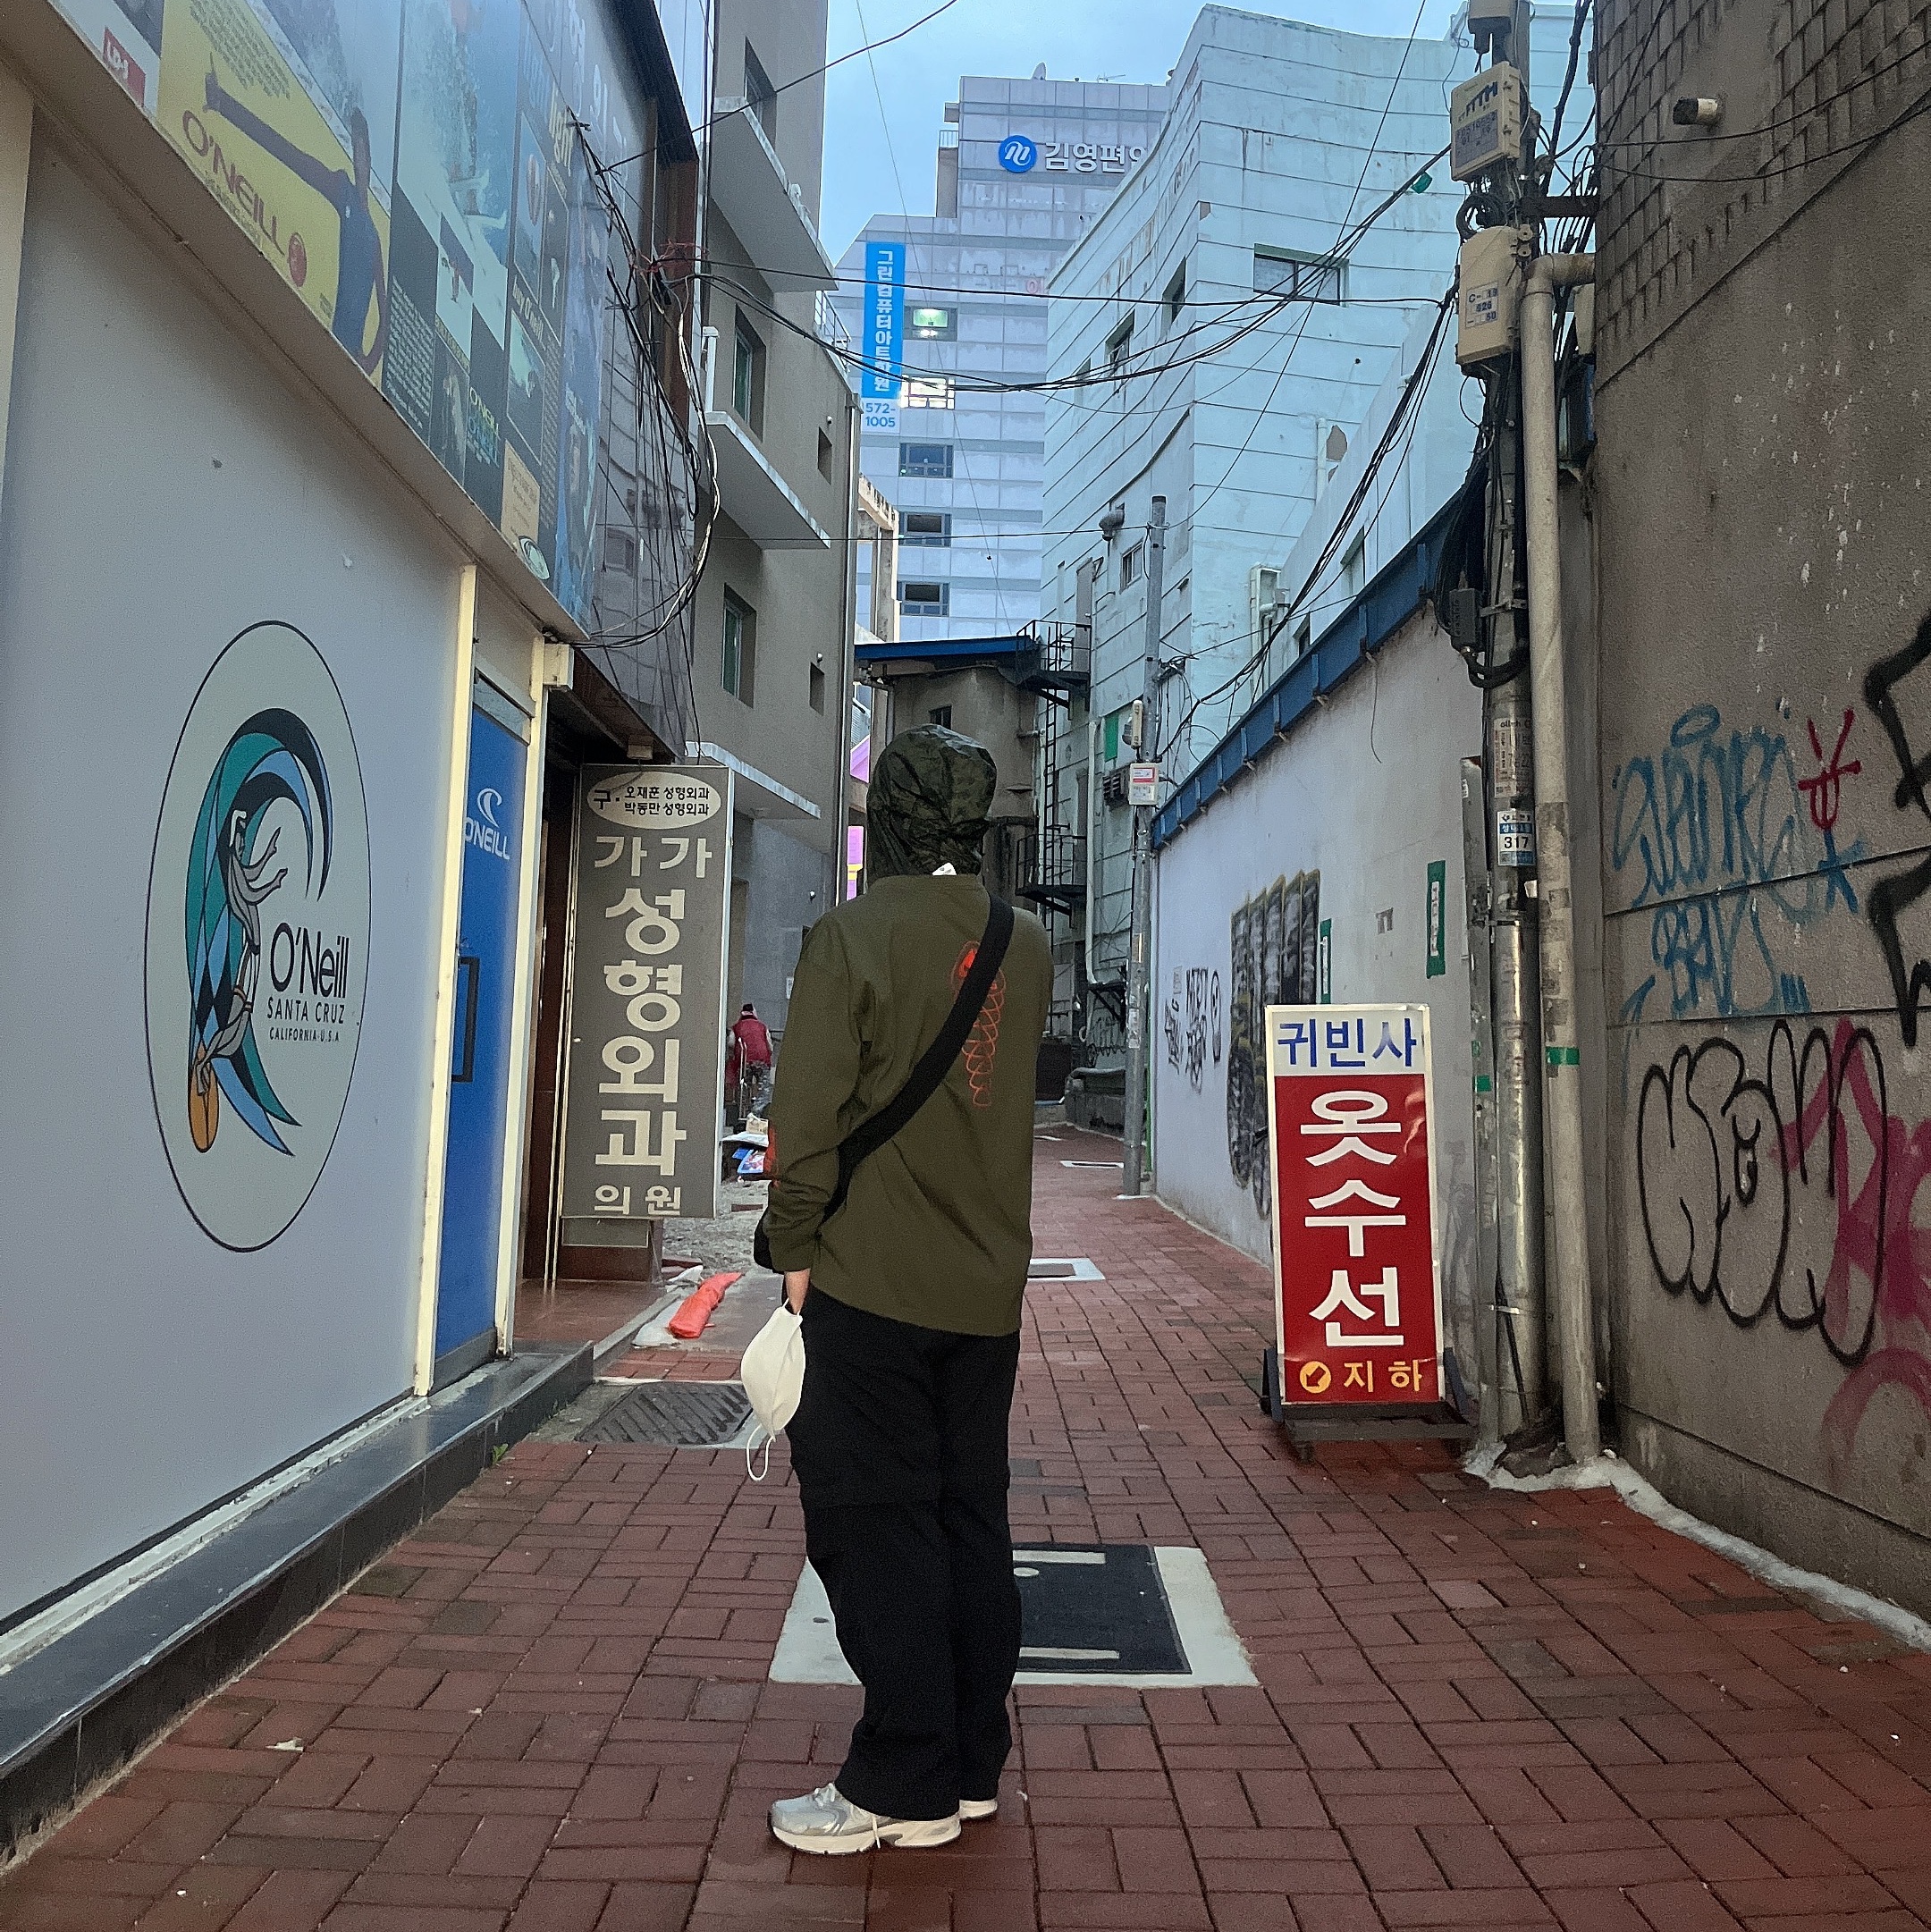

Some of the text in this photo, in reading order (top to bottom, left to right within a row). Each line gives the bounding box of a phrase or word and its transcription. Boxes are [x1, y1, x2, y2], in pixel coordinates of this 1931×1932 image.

[865, 416, 896, 427] 1005
[866, 402, 896, 414] 572-
[624, 786, 710, 801] 오재훈 성형외과
[624, 802, 710, 816] 박동만 성형외과
[465, 816, 510, 860] O'NEILL
[1504, 836, 1529, 848] 317
[594, 836, 714, 879] 가가
[270, 922, 350, 999] O'Neill
[267, 996, 345, 1025] SANTA CRUZ
[594, 888, 687, 1177] 성형외과
[1277, 1017, 1417, 1068] 귀빈사
[594, 1185, 681, 1217] 의원
[1300, 1090, 1406, 1347] 옷수선
[1343, 1359, 1423, 1394] 지하
